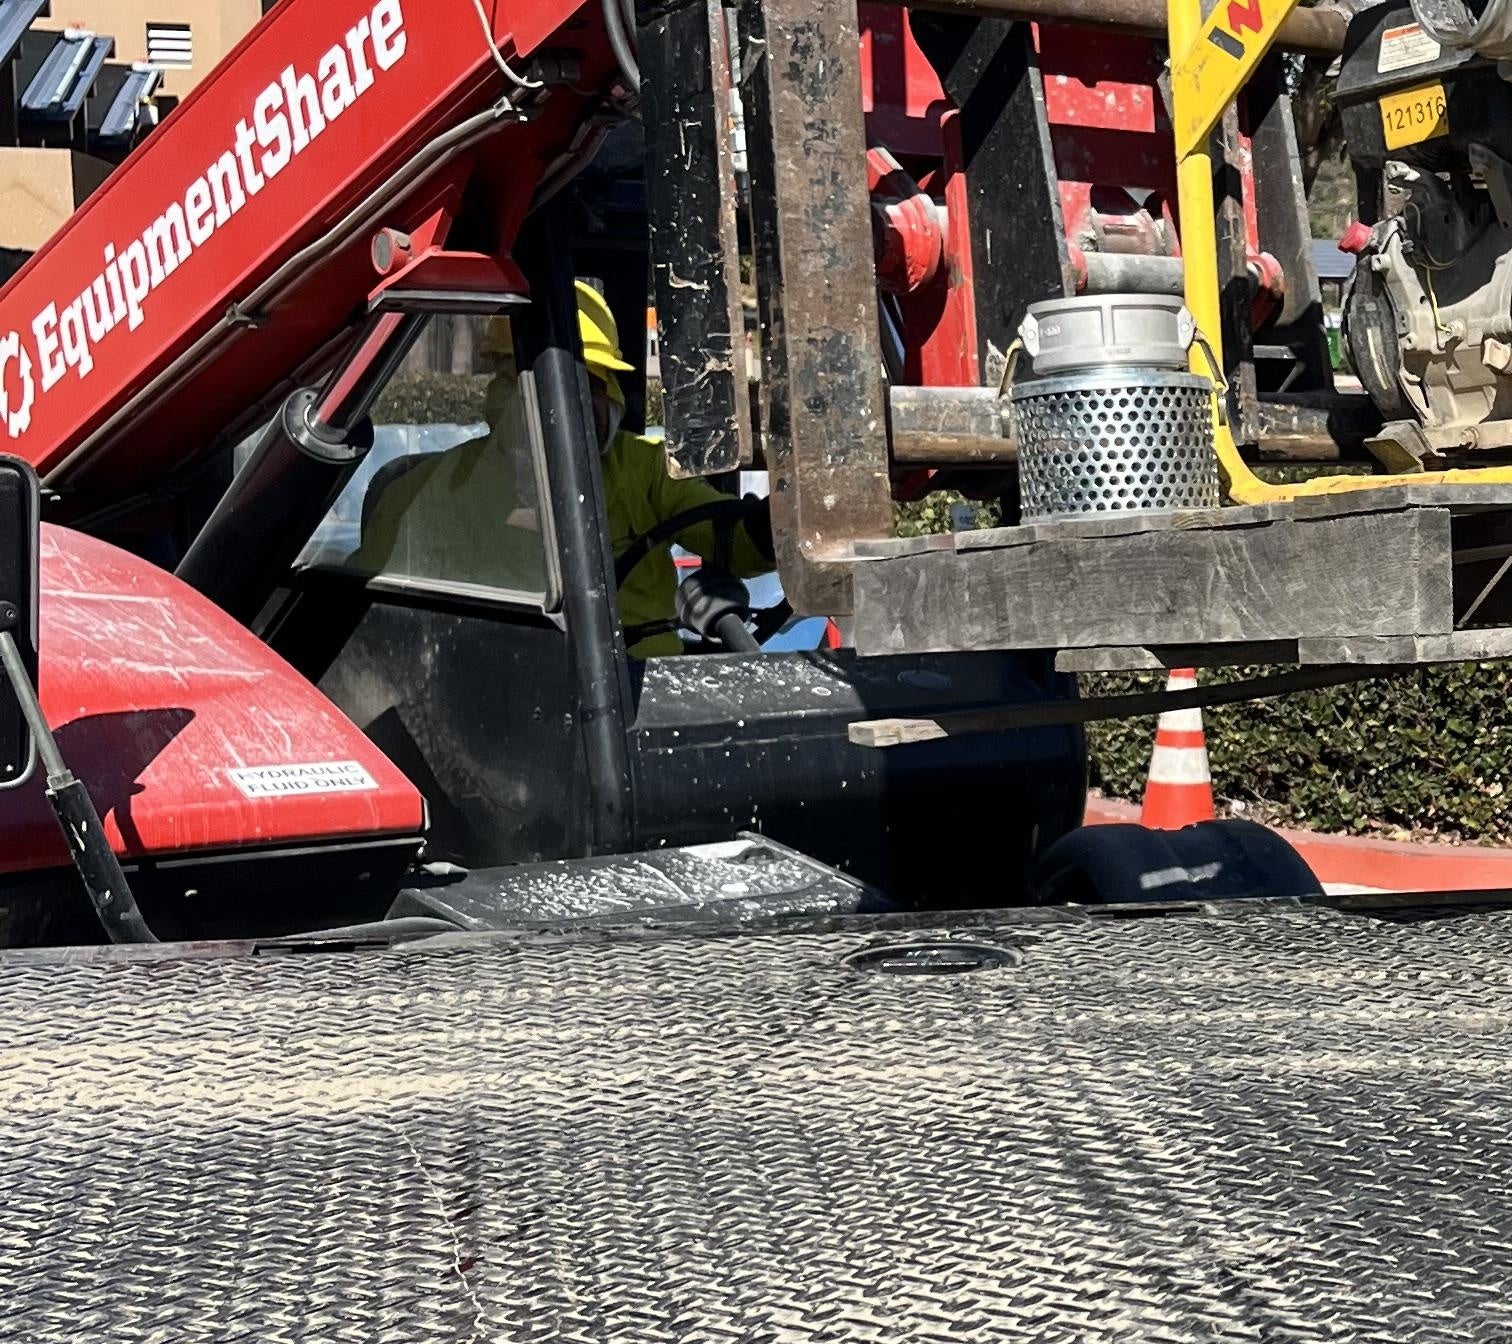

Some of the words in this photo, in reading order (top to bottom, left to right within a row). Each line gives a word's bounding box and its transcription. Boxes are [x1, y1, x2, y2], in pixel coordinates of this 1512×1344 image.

[1386, 96, 1445, 132] 121316
[236, 764, 360, 780] HYDRAULIC
[247, 781, 309, 793] FLUID
[314, 776, 366, 788] ONLY
